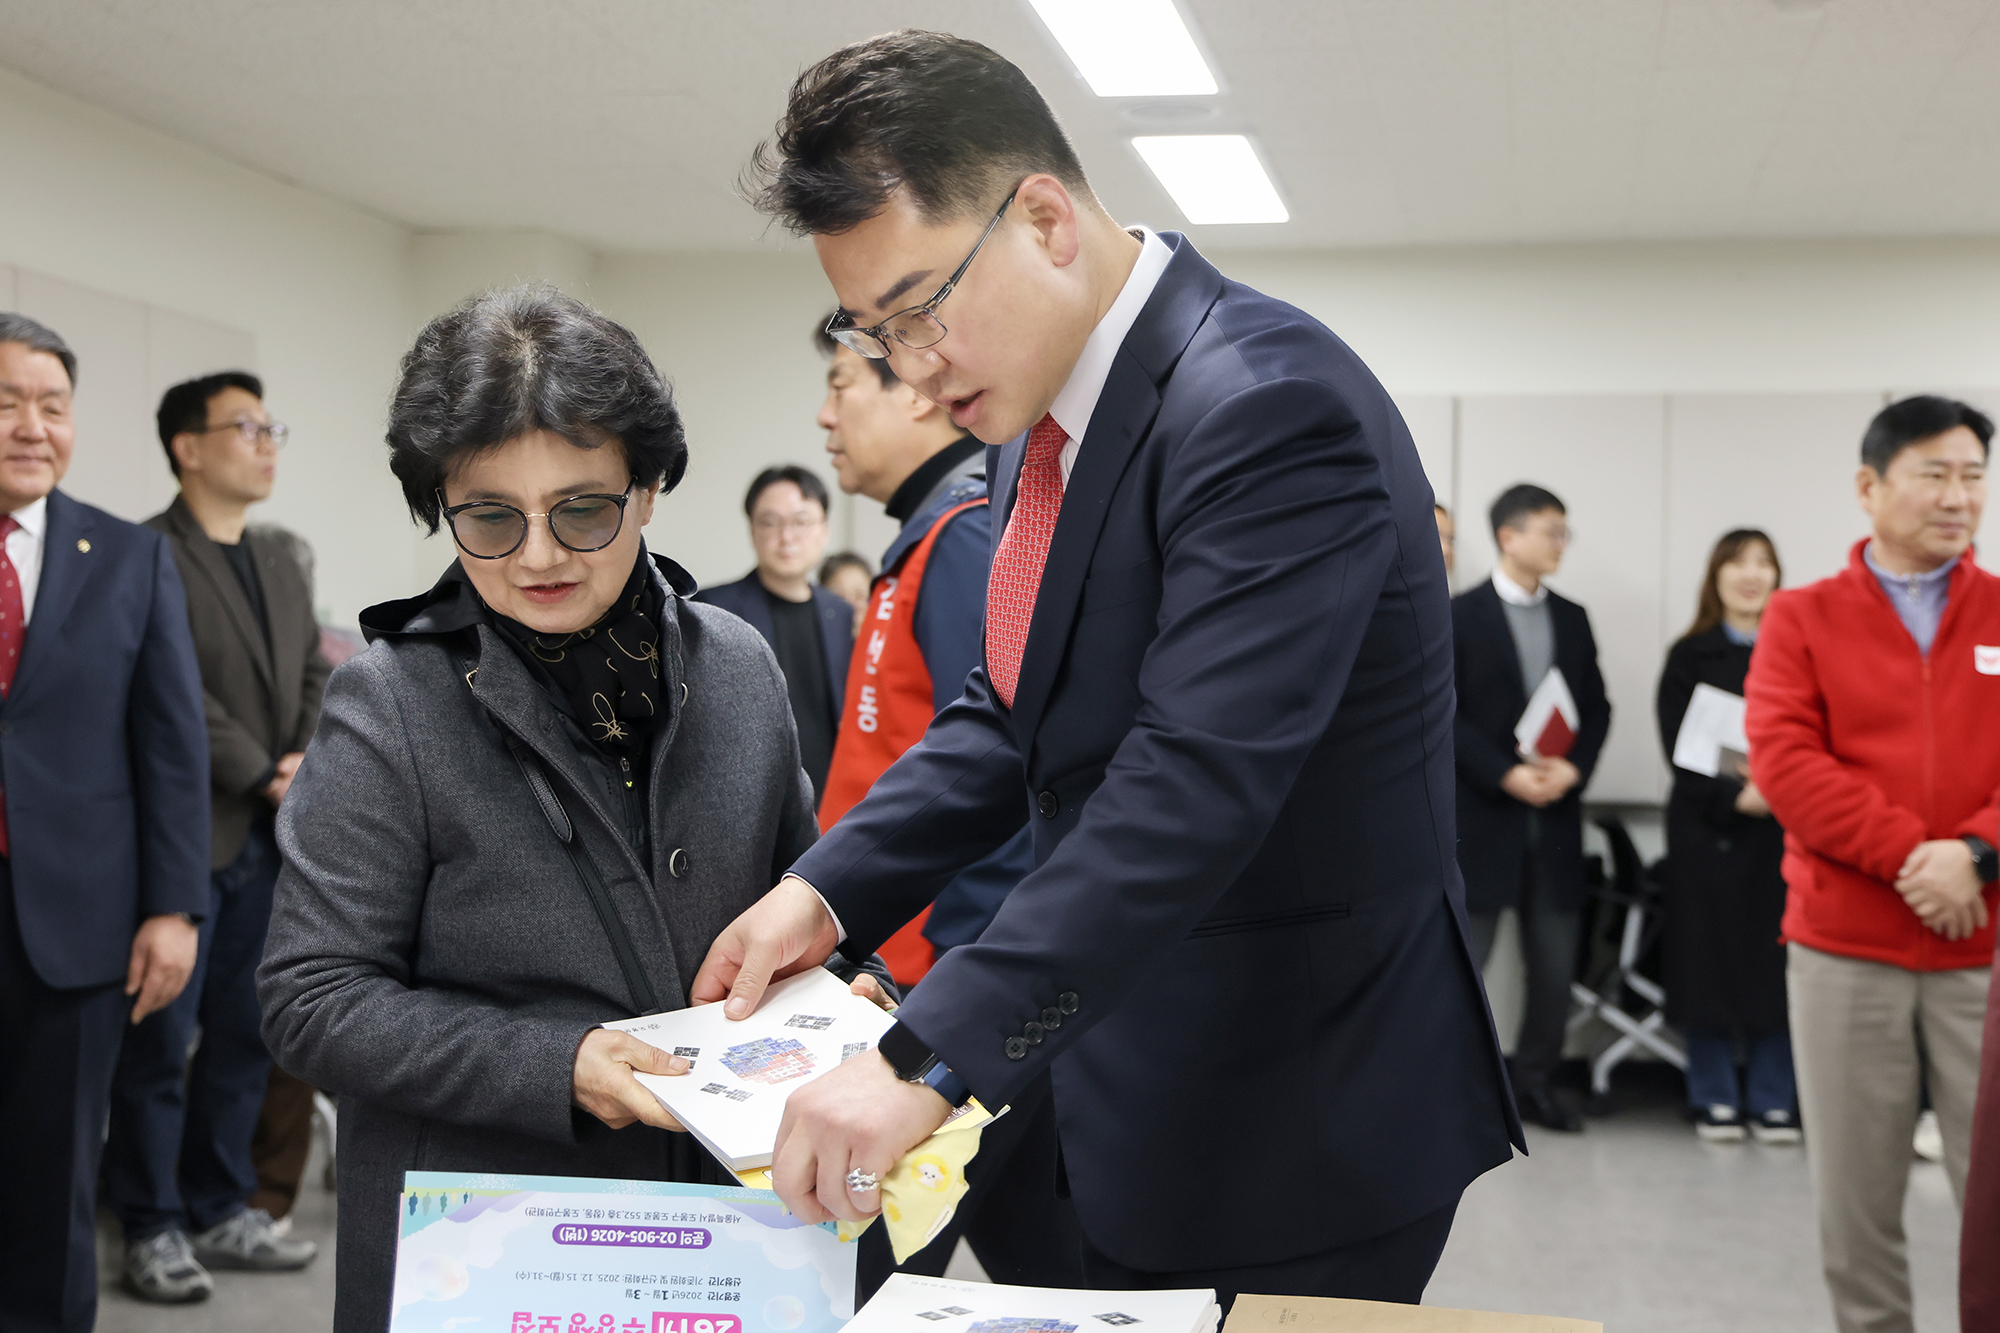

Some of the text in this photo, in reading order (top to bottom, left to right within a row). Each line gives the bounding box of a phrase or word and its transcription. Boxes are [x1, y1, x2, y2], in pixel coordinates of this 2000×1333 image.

[524, 1207, 580, 1218] 도봉구민회관)
[582, 1208, 605, 1218] (창동,
[644, 1212, 669, 1221] 도봉로
[672, 1212, 697, 1222] 도봉구
[700, 1214, 741, 1223] 서울특별시
[560, 1227, 704, 1245] 문의 02-905-4026 (1번)
[596, 1274, 620, 1282] 2025.
[622, 1274, 657, 1284] 신규회원:
[660, 1275, 668, 1284] 및
[670, 1276, 703, 1285] 기존회원
[708, 1276, 741, 1286] 신청기간
[626, 1289, 641, 1300] 3월
[653, 1290, 668, 1300] 1월
[672, 1290, 702, 1300] 2026년
[708, 1292, 741, 1302] 운영기간
[511, 1312, 562, 1333] 모집
